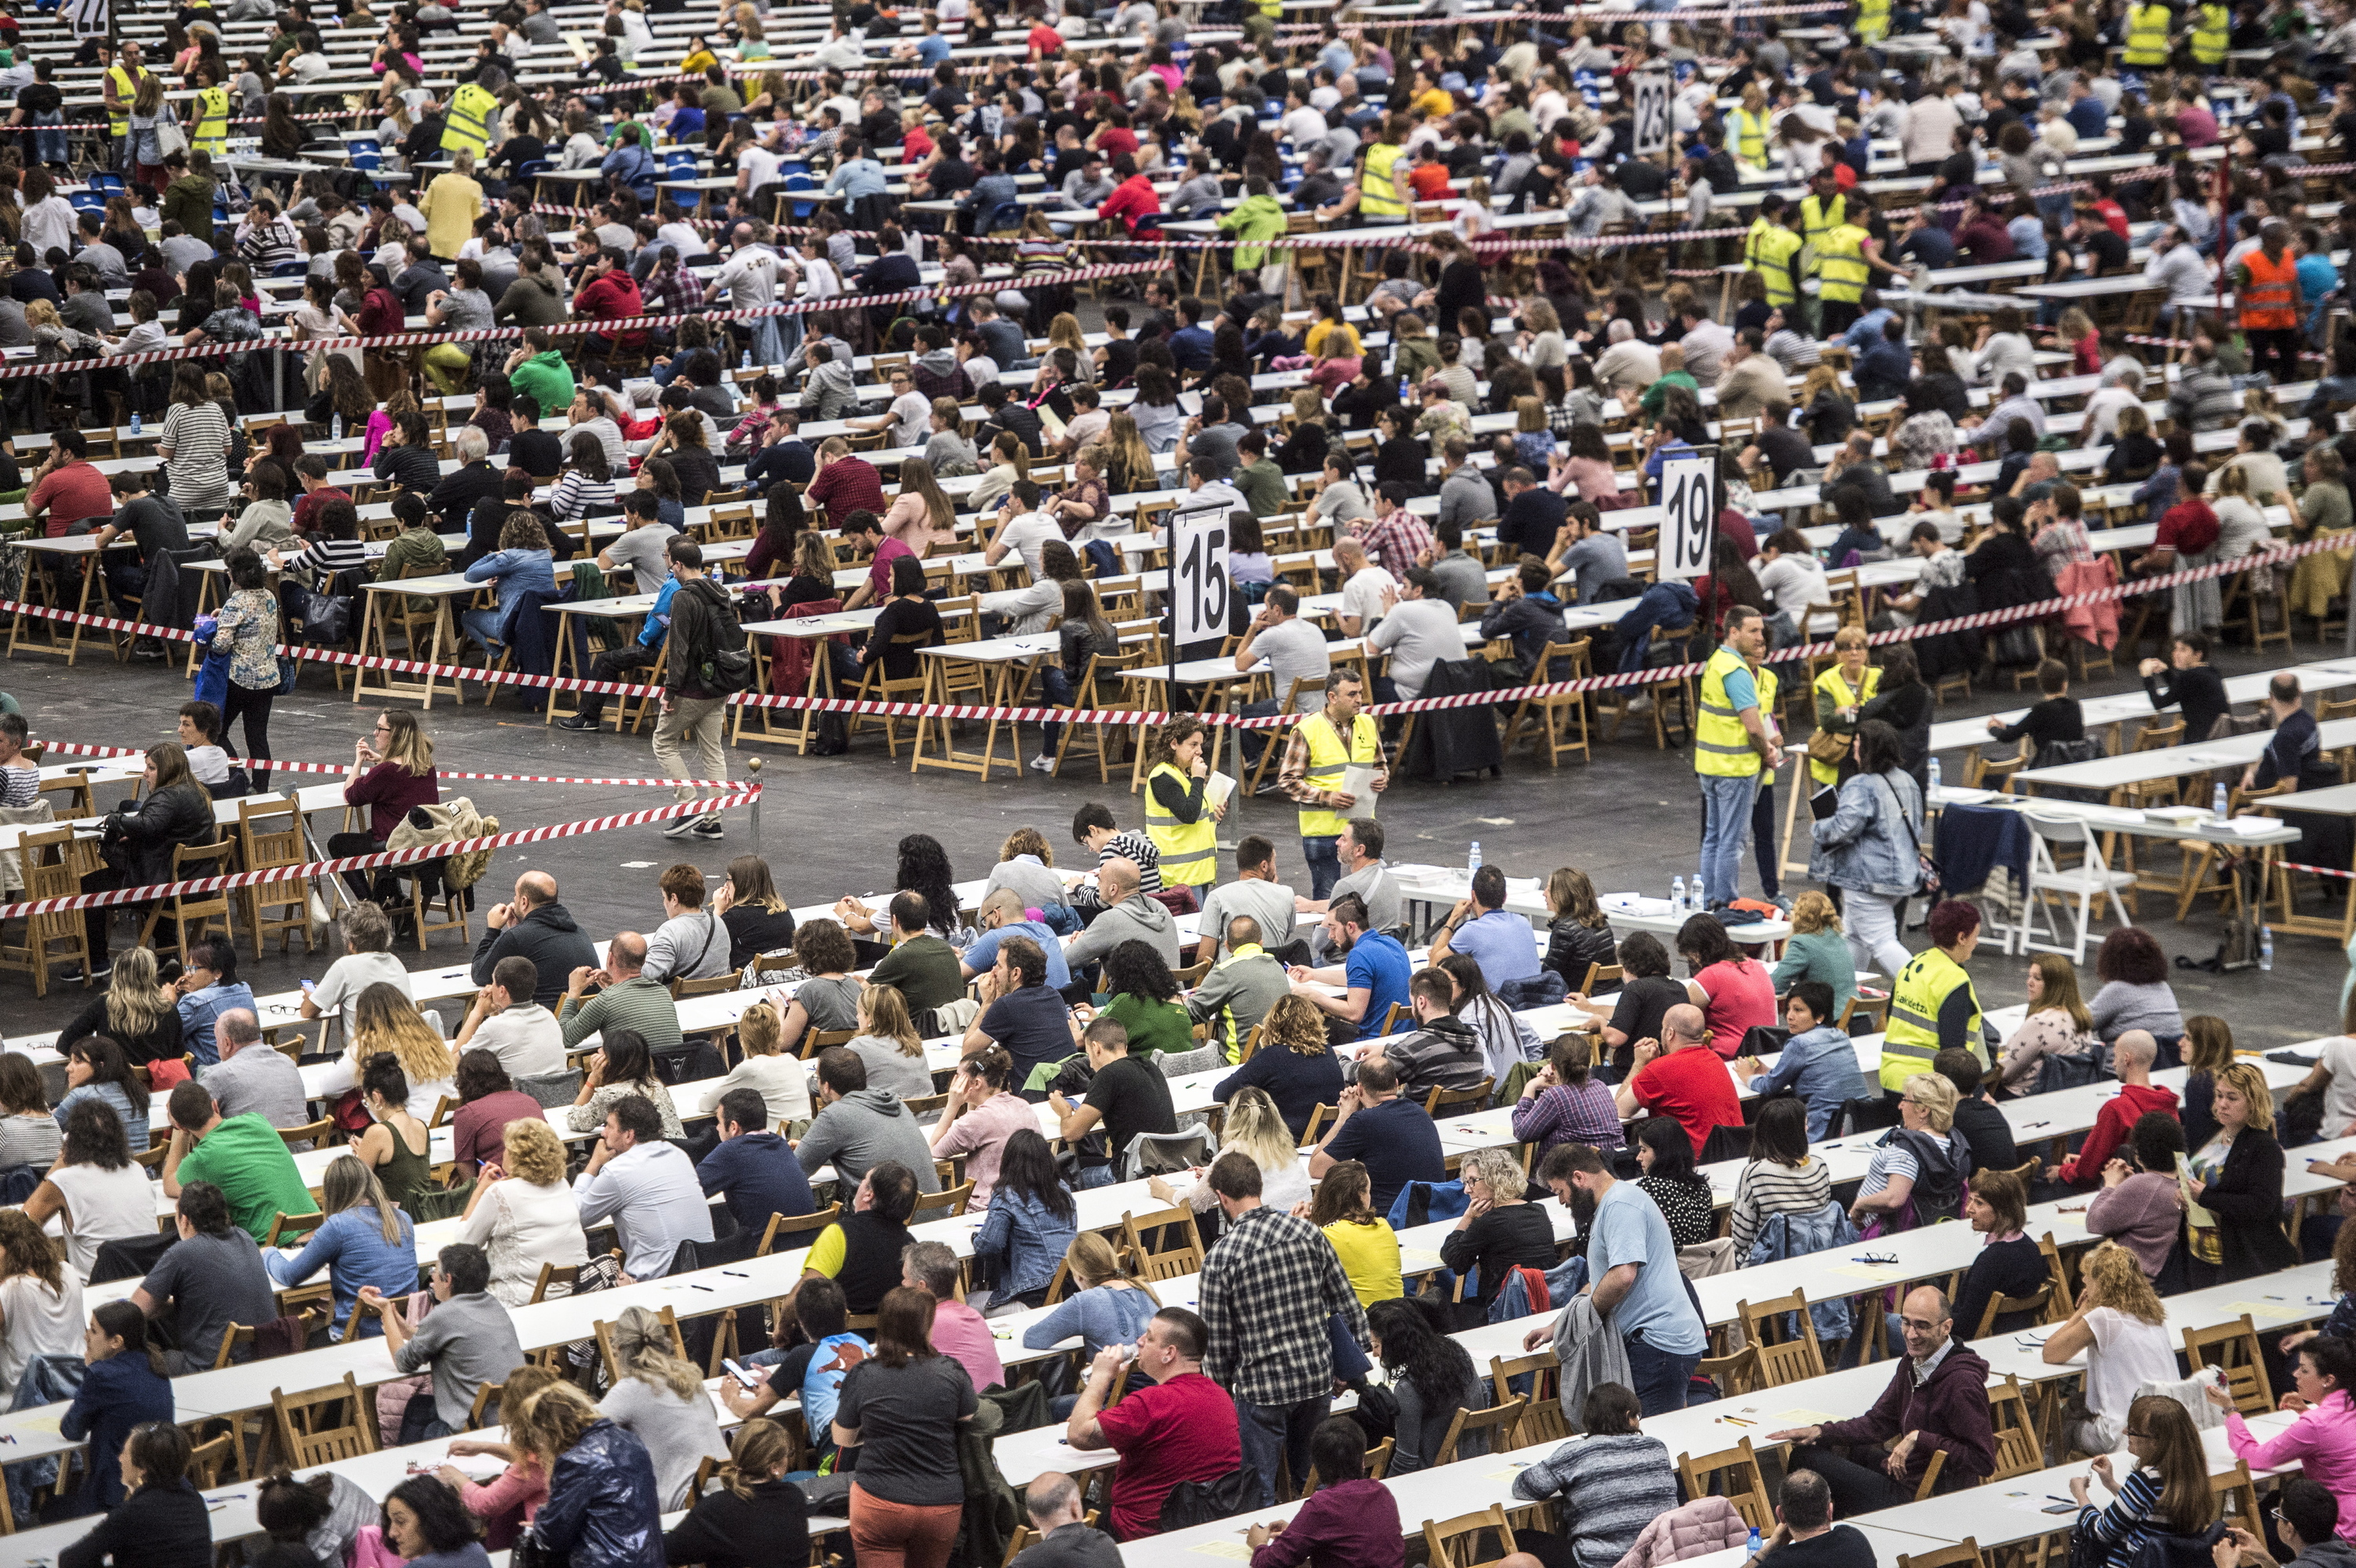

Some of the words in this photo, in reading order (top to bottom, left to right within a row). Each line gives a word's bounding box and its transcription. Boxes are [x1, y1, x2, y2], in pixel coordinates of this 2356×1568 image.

[1639, 86, 1666, 147] 23
[1669, 473, 1709, 568] 19
[1181, 528, 1227, 633] 15
